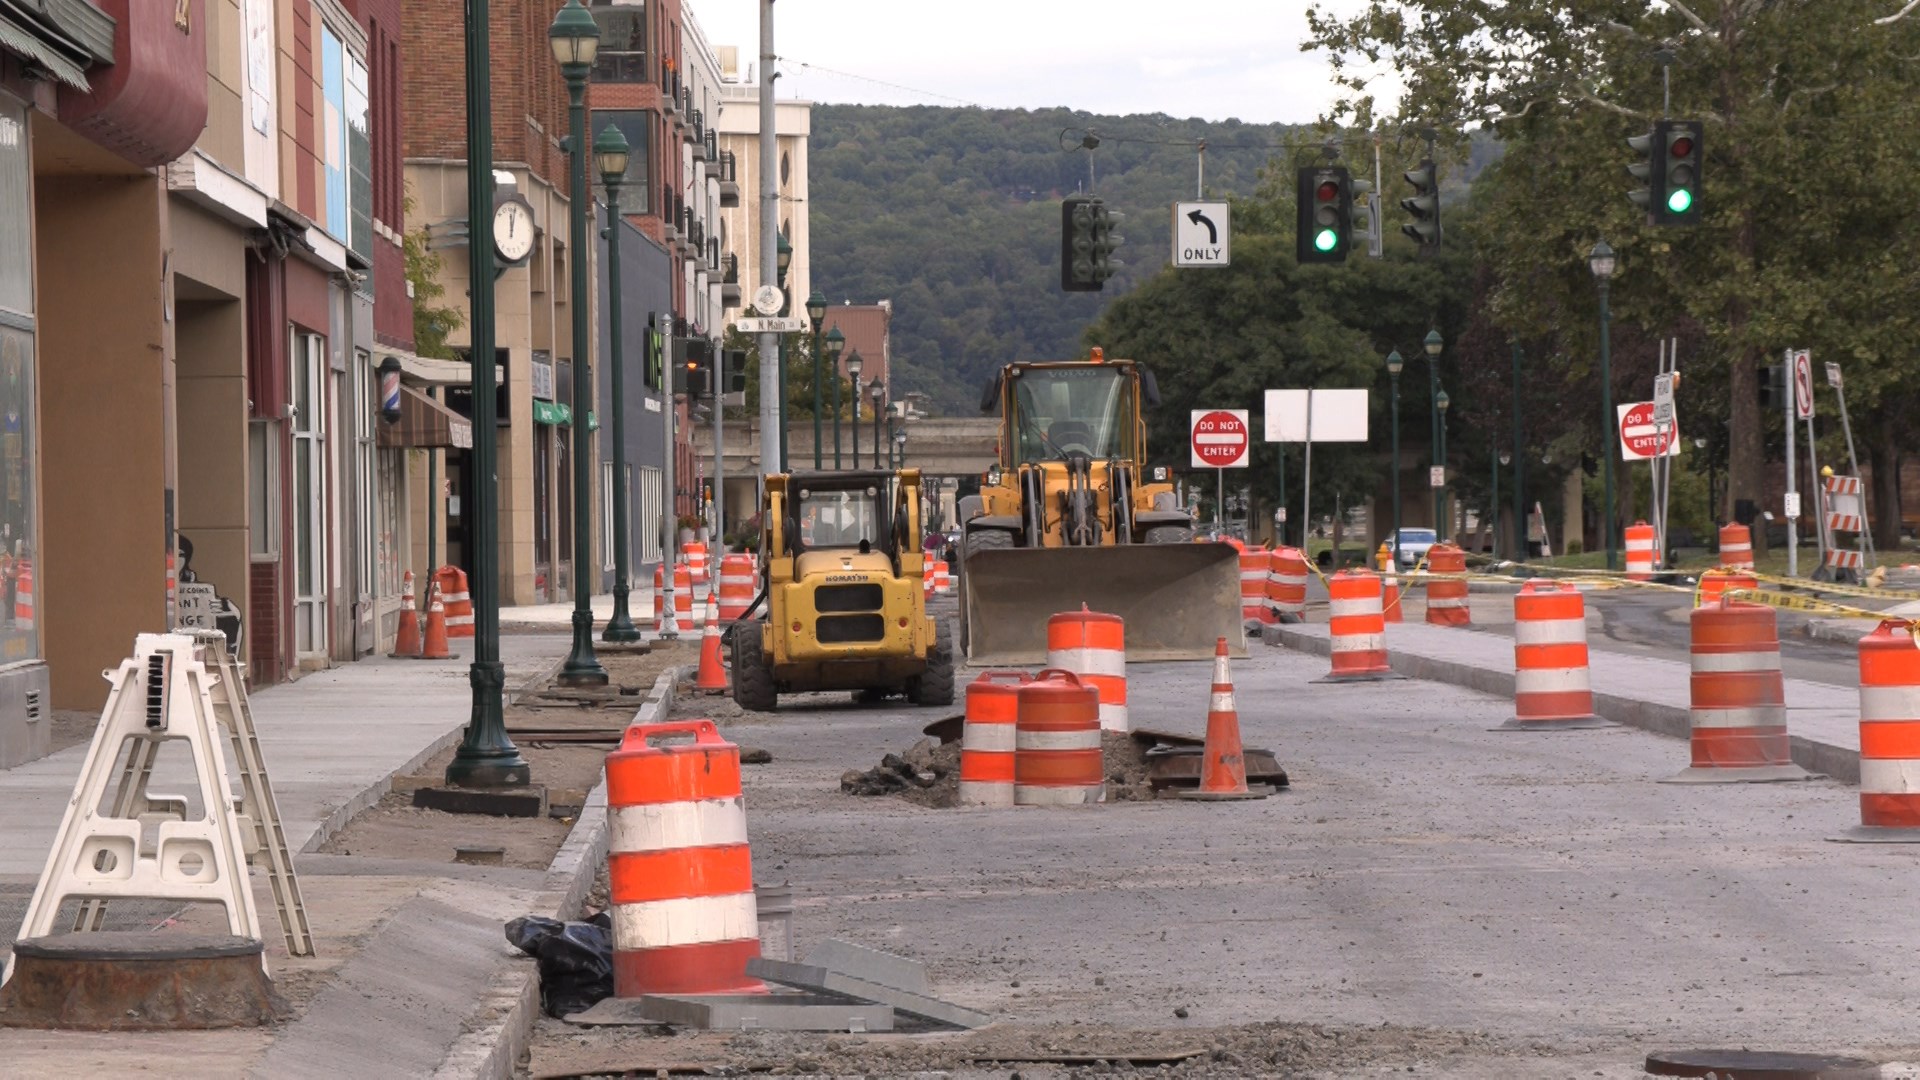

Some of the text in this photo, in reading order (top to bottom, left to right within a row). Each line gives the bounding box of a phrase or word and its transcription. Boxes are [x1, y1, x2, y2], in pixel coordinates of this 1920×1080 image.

[1184, 248, 1222, 260] ONLY
[767, 319, 786, 330] Main
[1047, 369, 1097, 378] VOLVO
[1626, 413, 1642, 424] DO
[1200, 421, 1240, 431] DO NOT
[1203, 447, 1236, 456] ENTER
